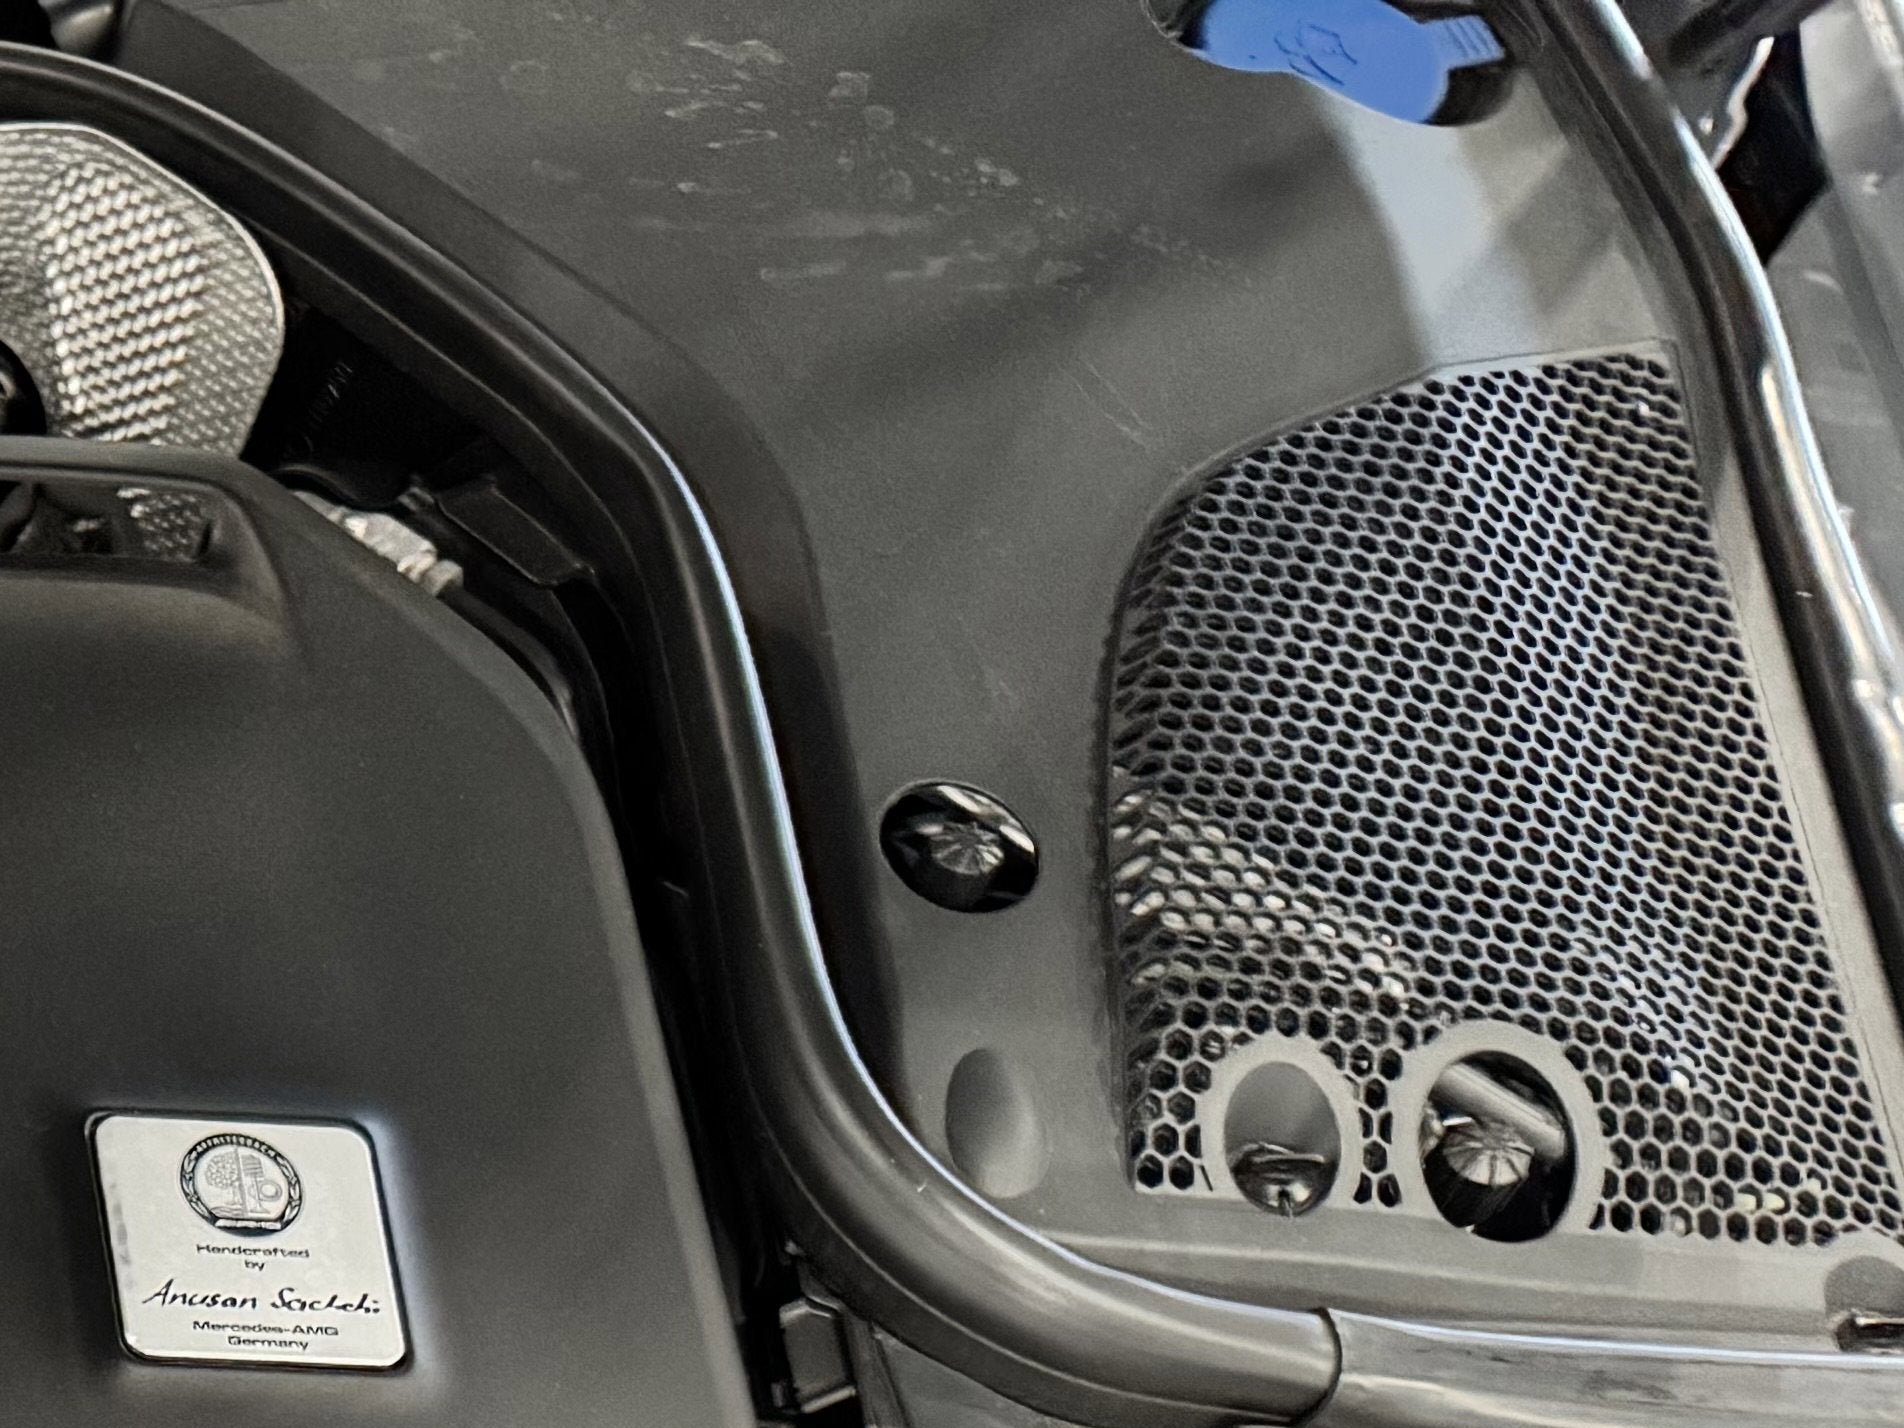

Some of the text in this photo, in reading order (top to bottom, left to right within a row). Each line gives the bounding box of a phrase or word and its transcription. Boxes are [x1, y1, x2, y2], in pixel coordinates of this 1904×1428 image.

[196, 1243, 310, 1258] Handcrafted
[244, 1259, 265, 1271] by
[192, 1320, 339, 1336] Mercedes-AMG
[228, 1335, 309, 1350] Germany
